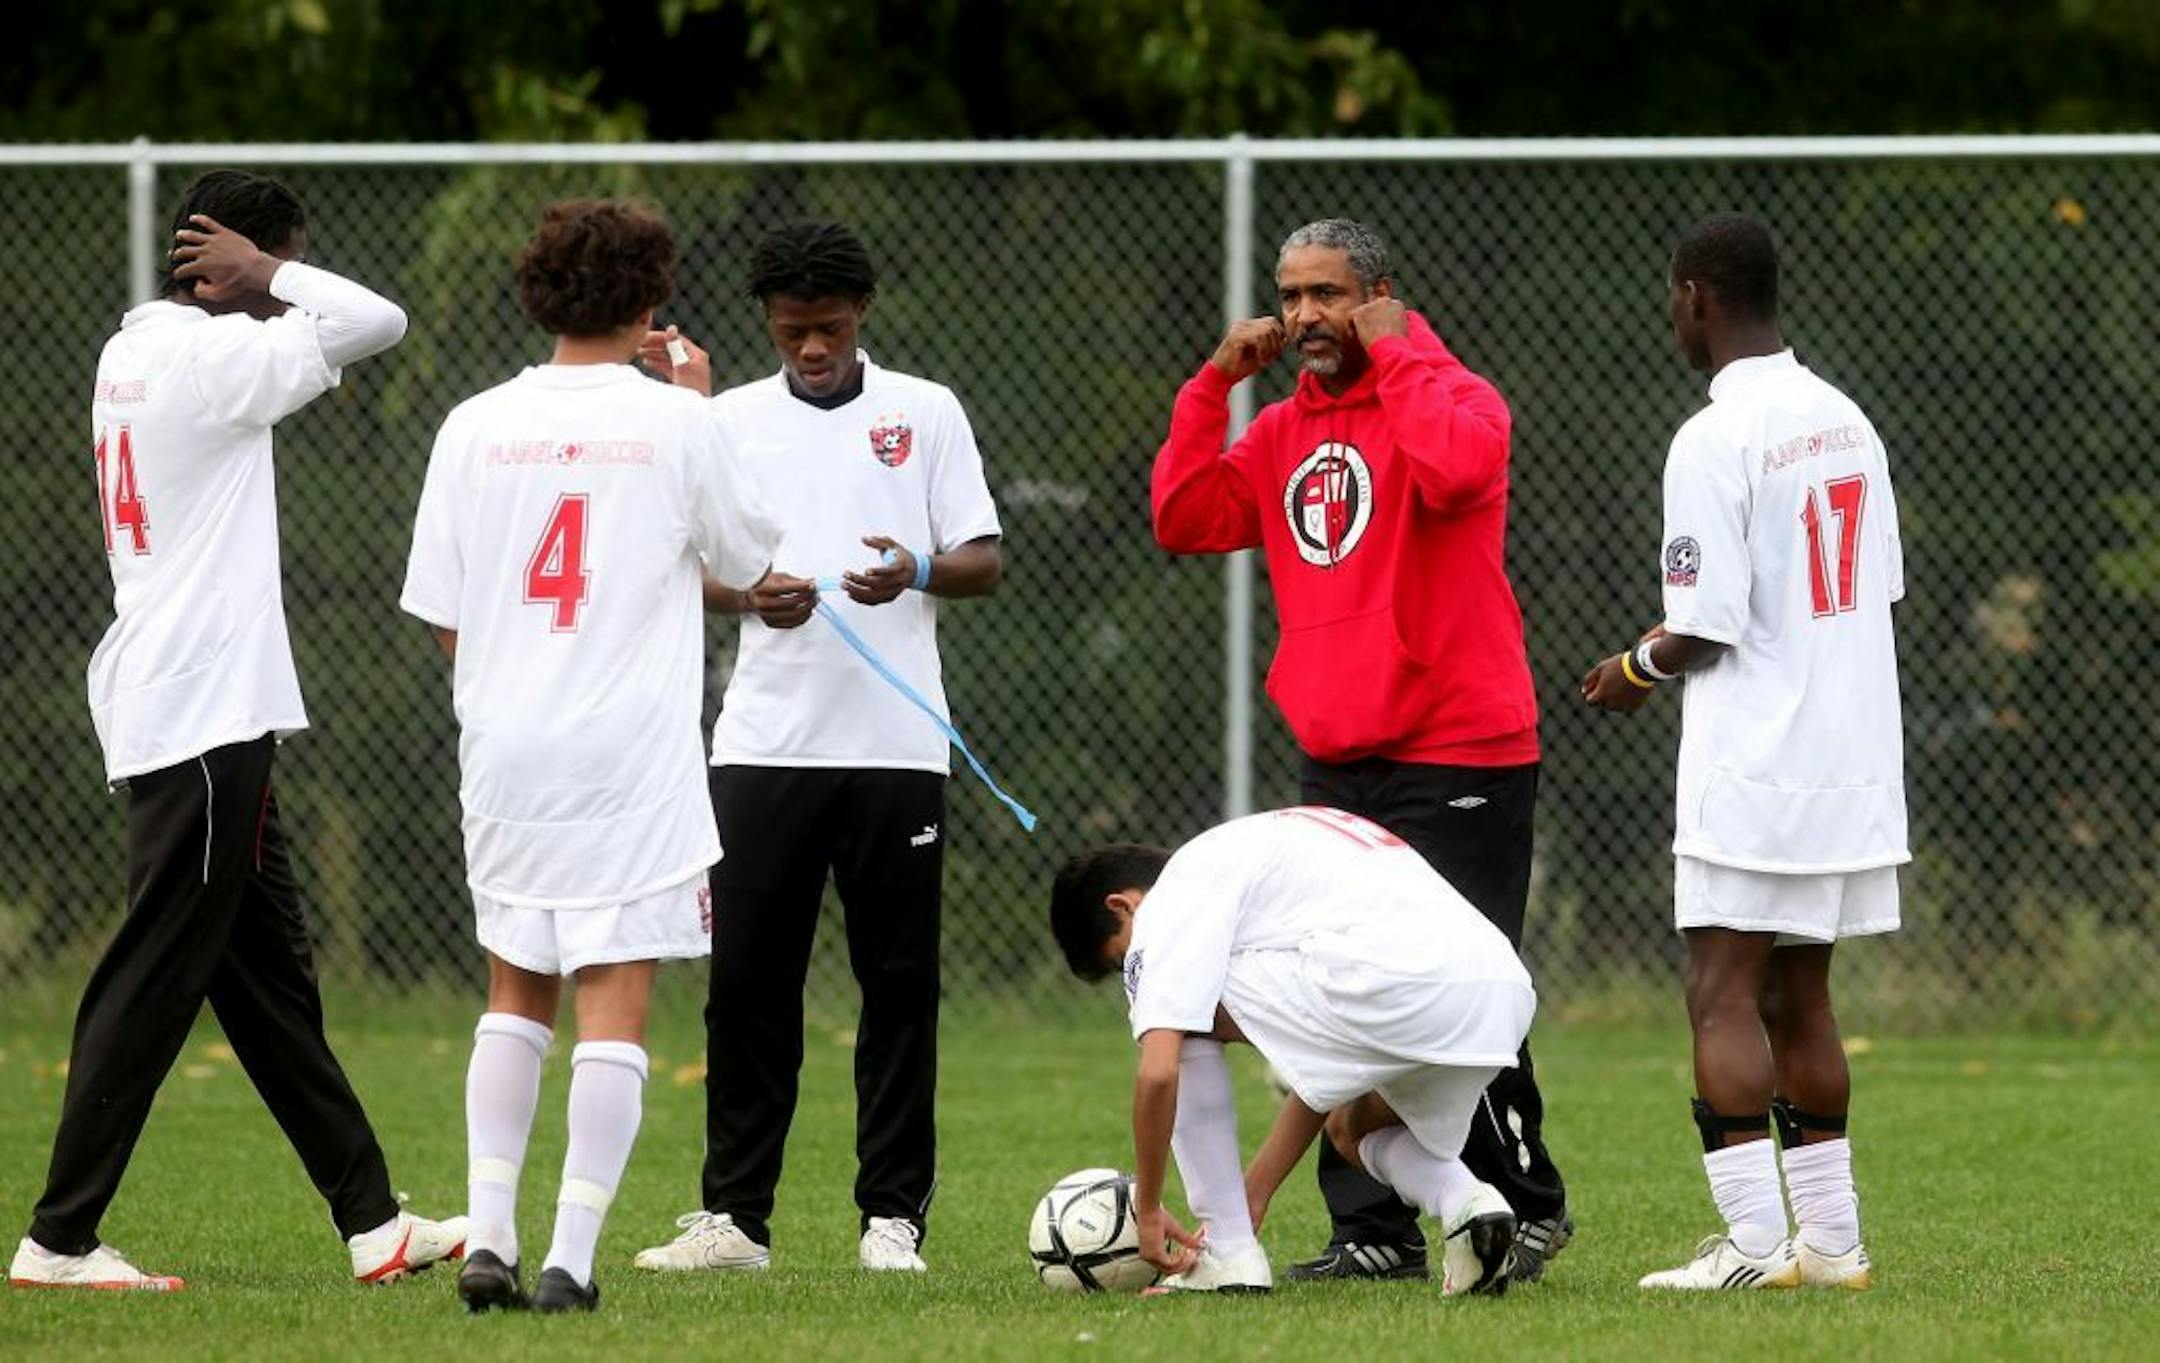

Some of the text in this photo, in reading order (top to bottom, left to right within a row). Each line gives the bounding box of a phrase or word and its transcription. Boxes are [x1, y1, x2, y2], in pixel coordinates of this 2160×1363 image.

[94, 422, 152, 556] 14
[1799, 472, 1868, 618] 17
[522, 491, 592, 634] 4
